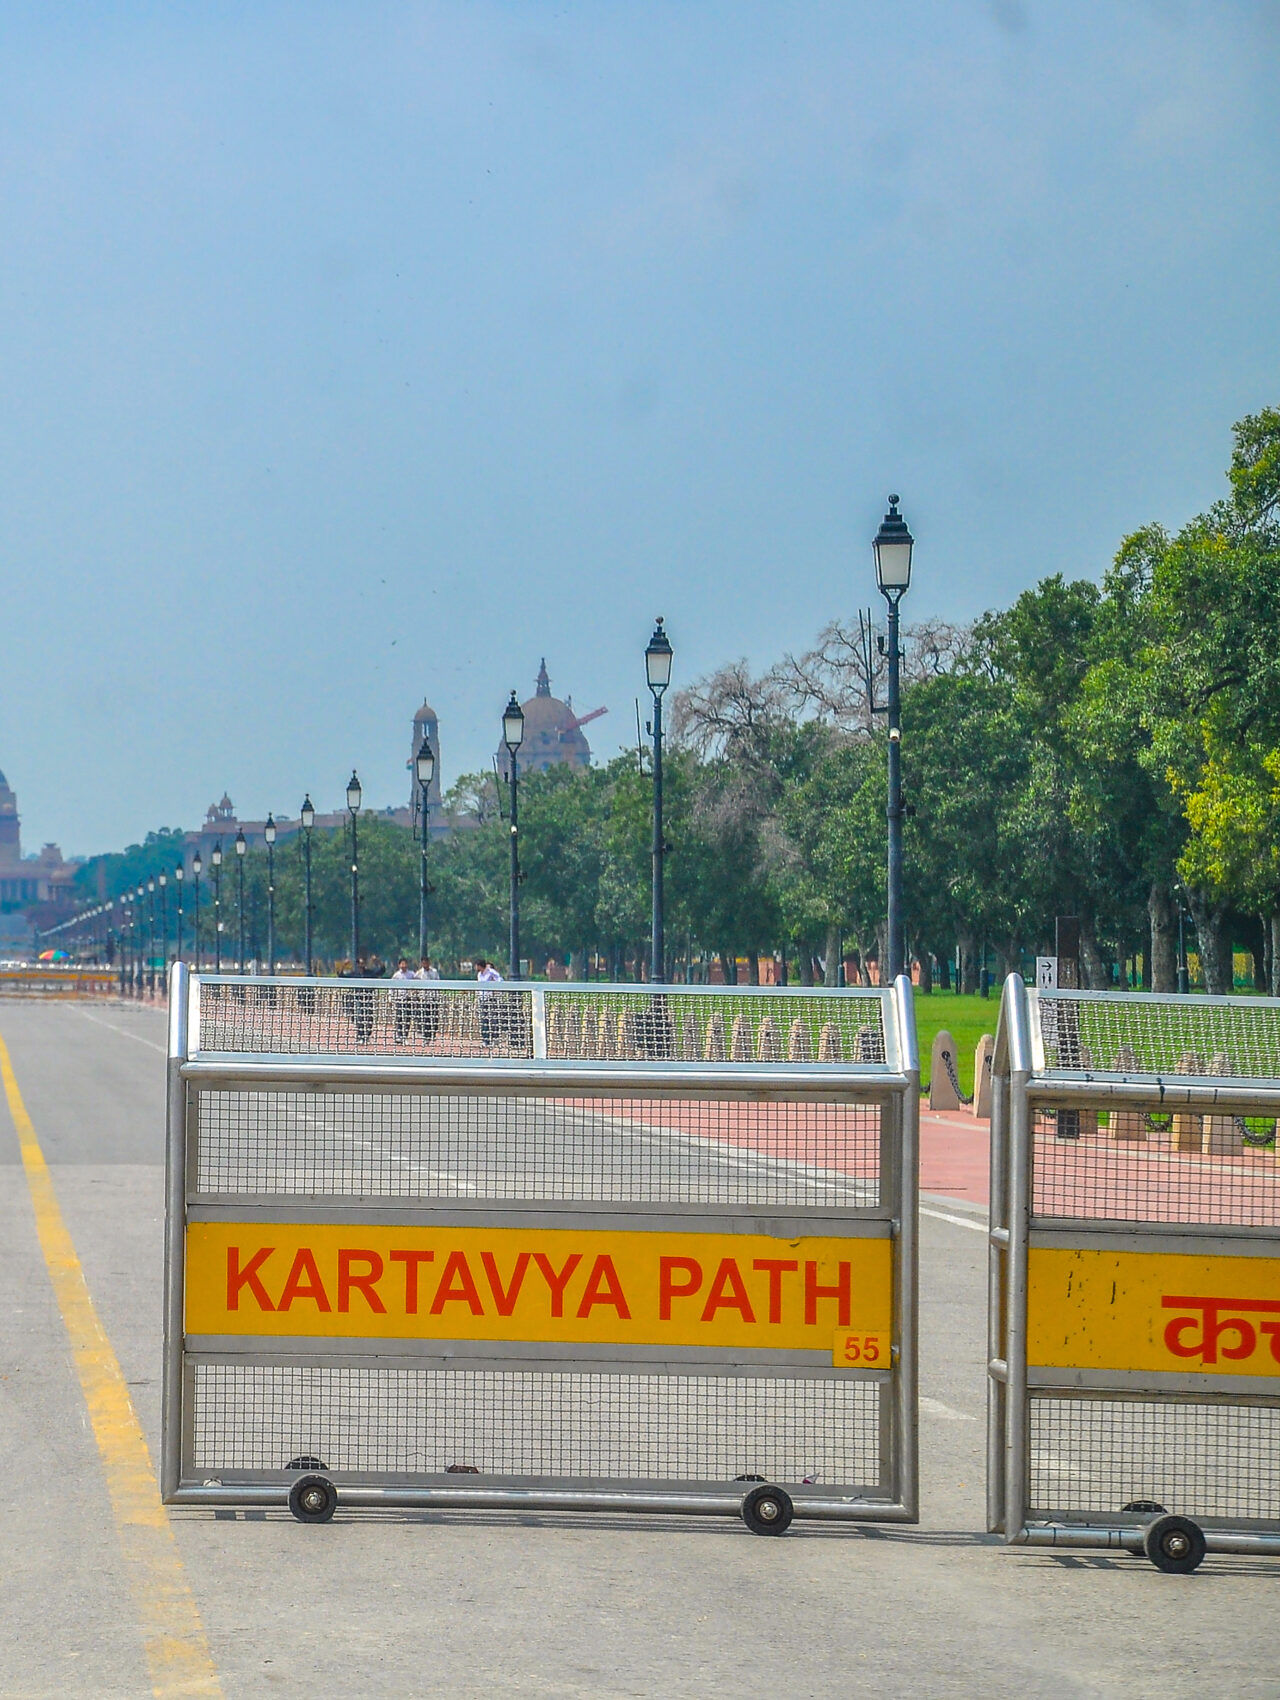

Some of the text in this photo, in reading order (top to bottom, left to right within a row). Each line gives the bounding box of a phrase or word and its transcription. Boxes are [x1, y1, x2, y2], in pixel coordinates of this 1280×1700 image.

[226, 1246, 852, 1327] KARTAVYA PATH
[844, 1336, 881, 1362] 55
